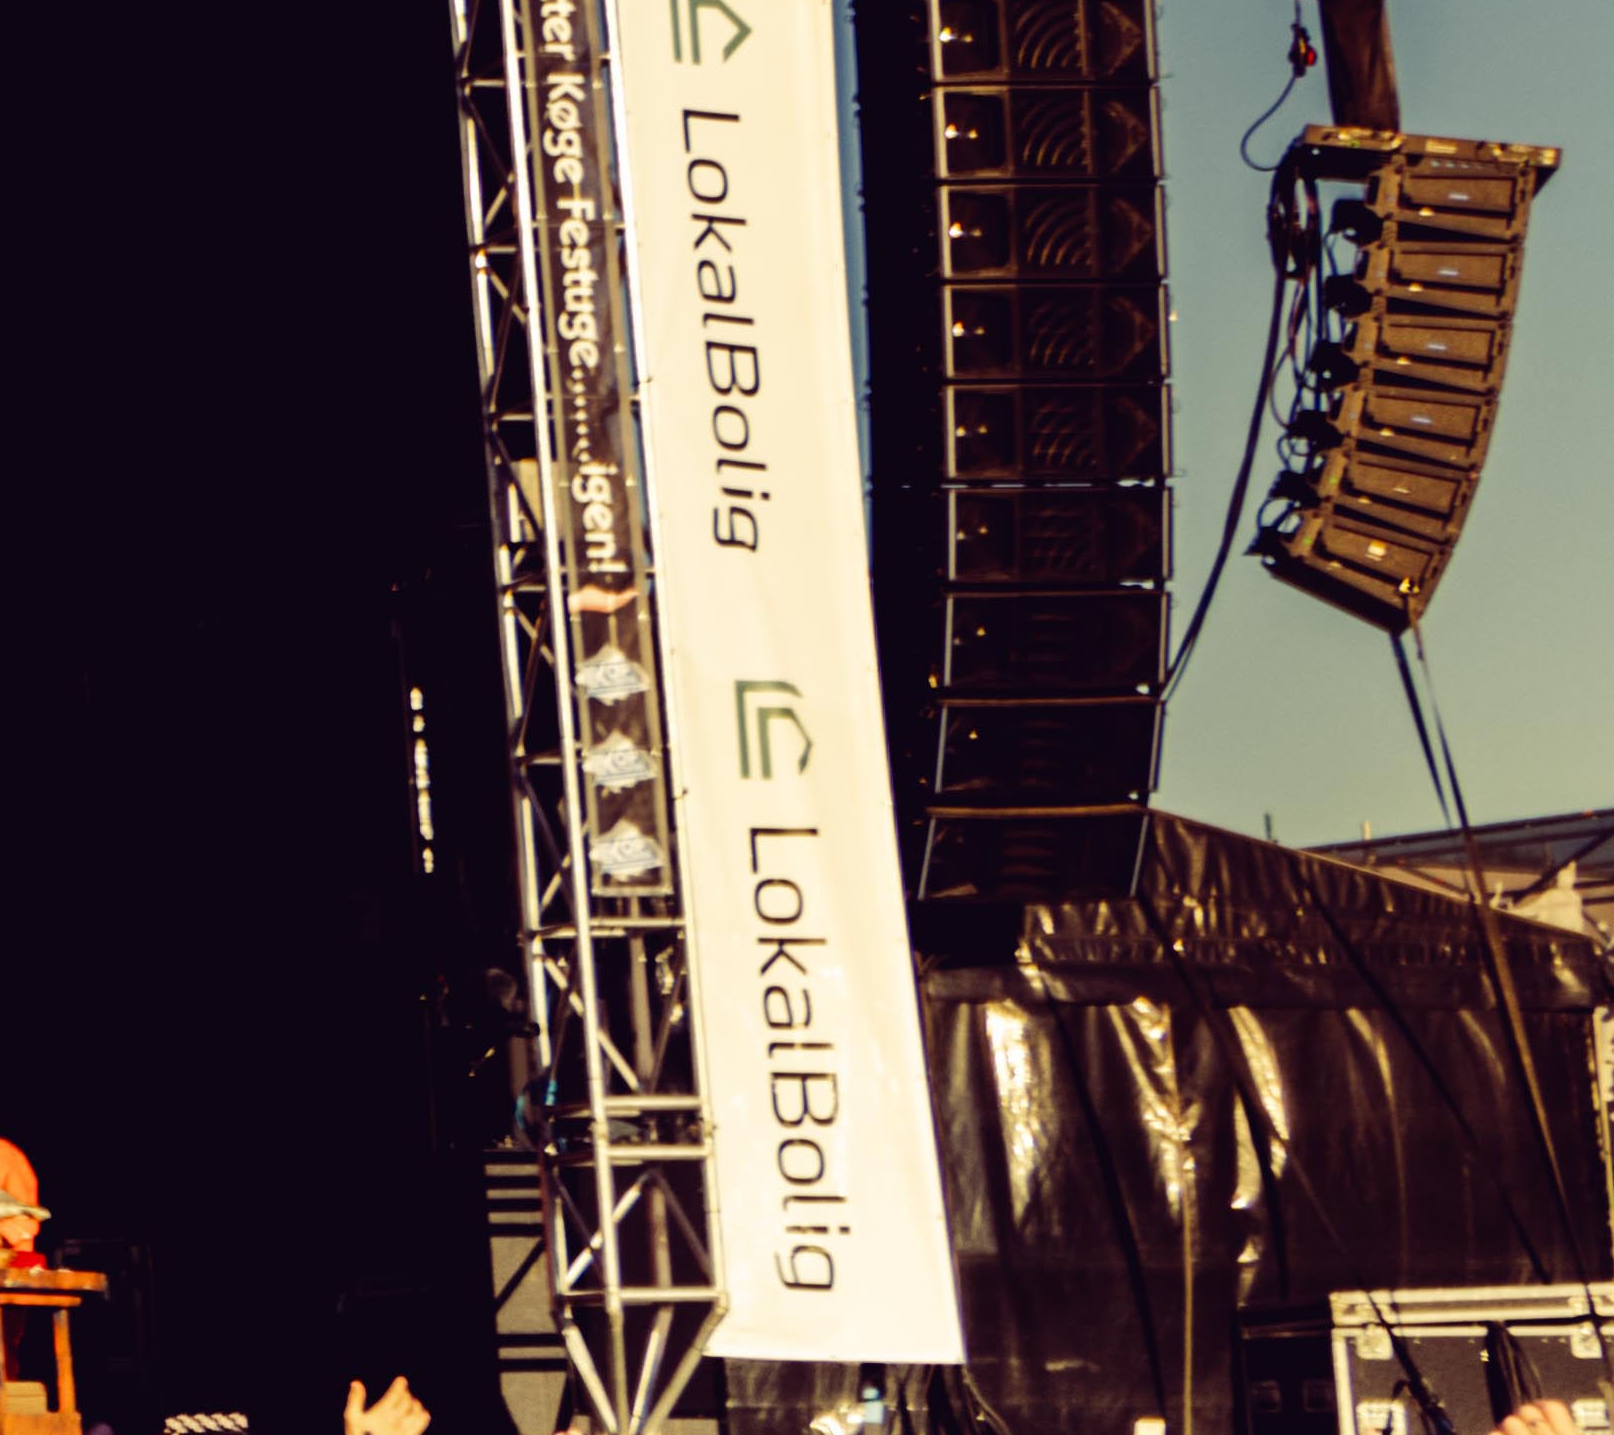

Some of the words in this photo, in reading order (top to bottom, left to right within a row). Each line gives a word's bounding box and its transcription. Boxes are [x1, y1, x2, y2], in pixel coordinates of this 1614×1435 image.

[542, 71, 587, 185] Køge
[681, 107, 769, 554] LokalBolig
[749, 827, 850, 1293] LokalBolig
